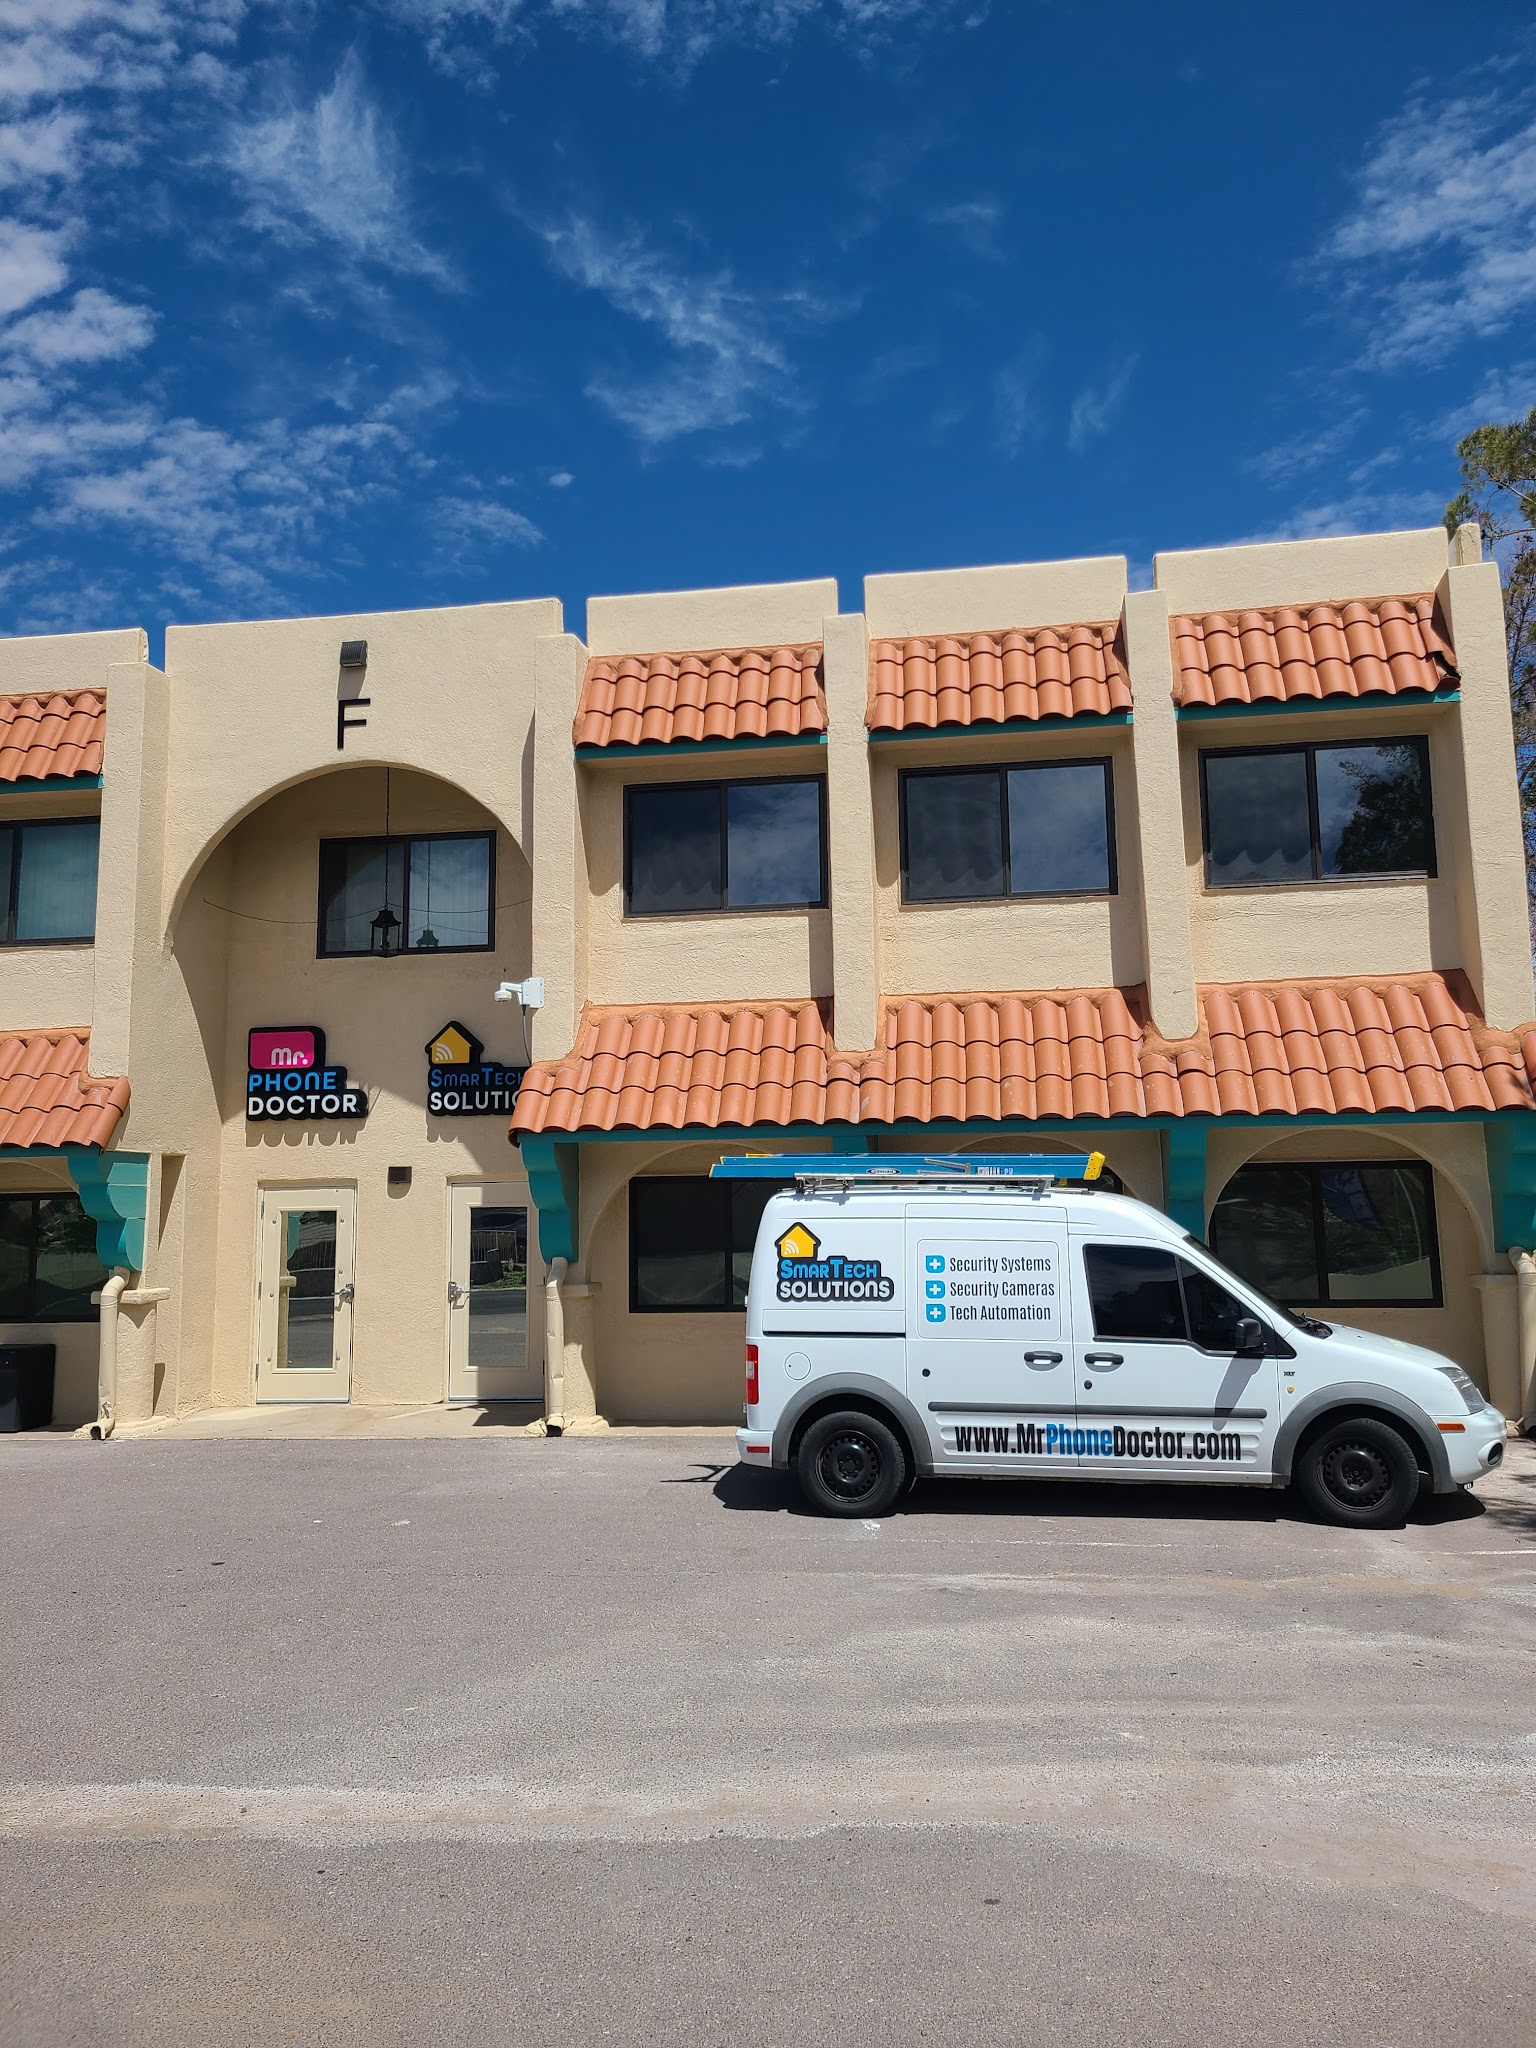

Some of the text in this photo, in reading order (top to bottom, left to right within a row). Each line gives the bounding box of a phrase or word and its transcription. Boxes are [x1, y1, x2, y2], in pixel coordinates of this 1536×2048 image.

[337, 698, 371, 750] F
[249, 1071, 337, 1092] PHONE
[248, 1094, 358, 1116] DOCTOR
[949, 1256, 1052, 1274] Security Systems
[780, 1280, 891, 1299] SOLUTIONS
[950, 1280, 1055, 1299] Security Cameras
[949, 1304, 1052, 1321] Tech Automation
[954, 1423, 1242, 1461] www.MrPhoneDoctor.com
